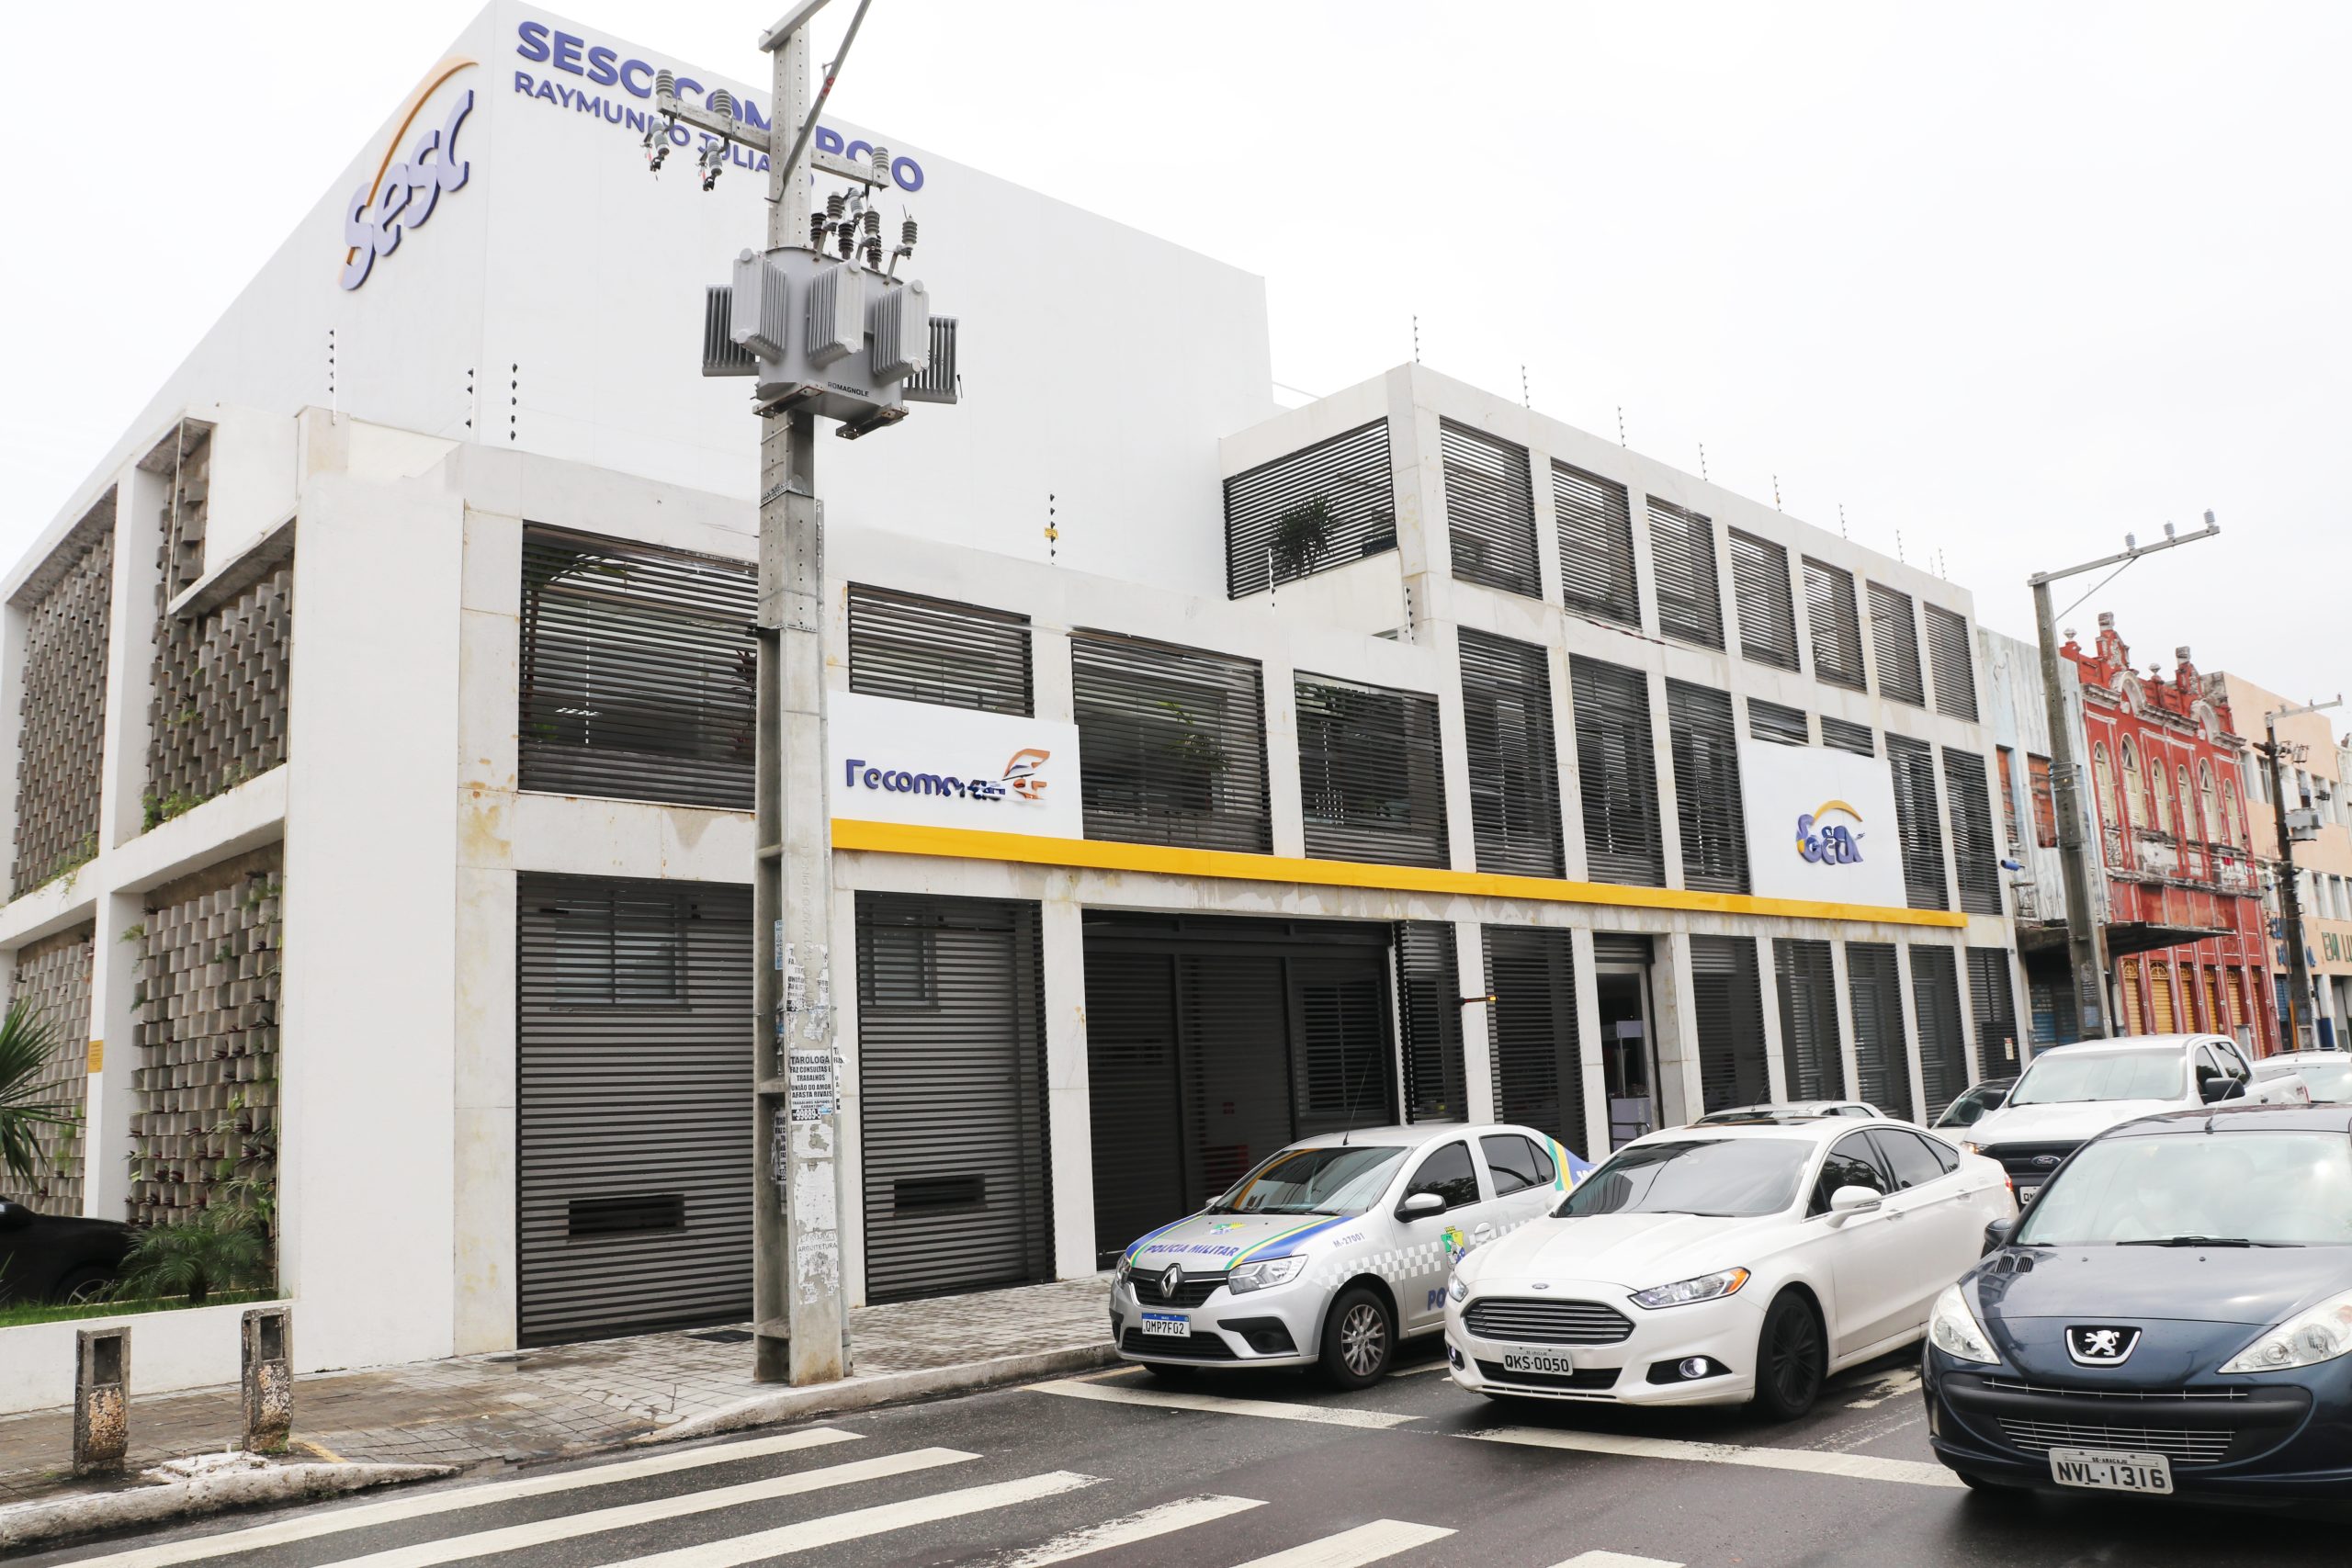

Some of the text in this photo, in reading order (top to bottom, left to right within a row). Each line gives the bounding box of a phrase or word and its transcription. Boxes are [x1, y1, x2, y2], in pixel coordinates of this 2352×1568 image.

[516, 20, 655, 99] SESC
[827, 381, 870, 398] ROMAGNOLE
[790, 1066, 799, 1074] FAZ
[797, 1242, 838, 1252] ARQUITETURA
[1187, 1244, 1240, 1257] MILITAR
[1145, 1320, 1185, 1335] QMP7F02
